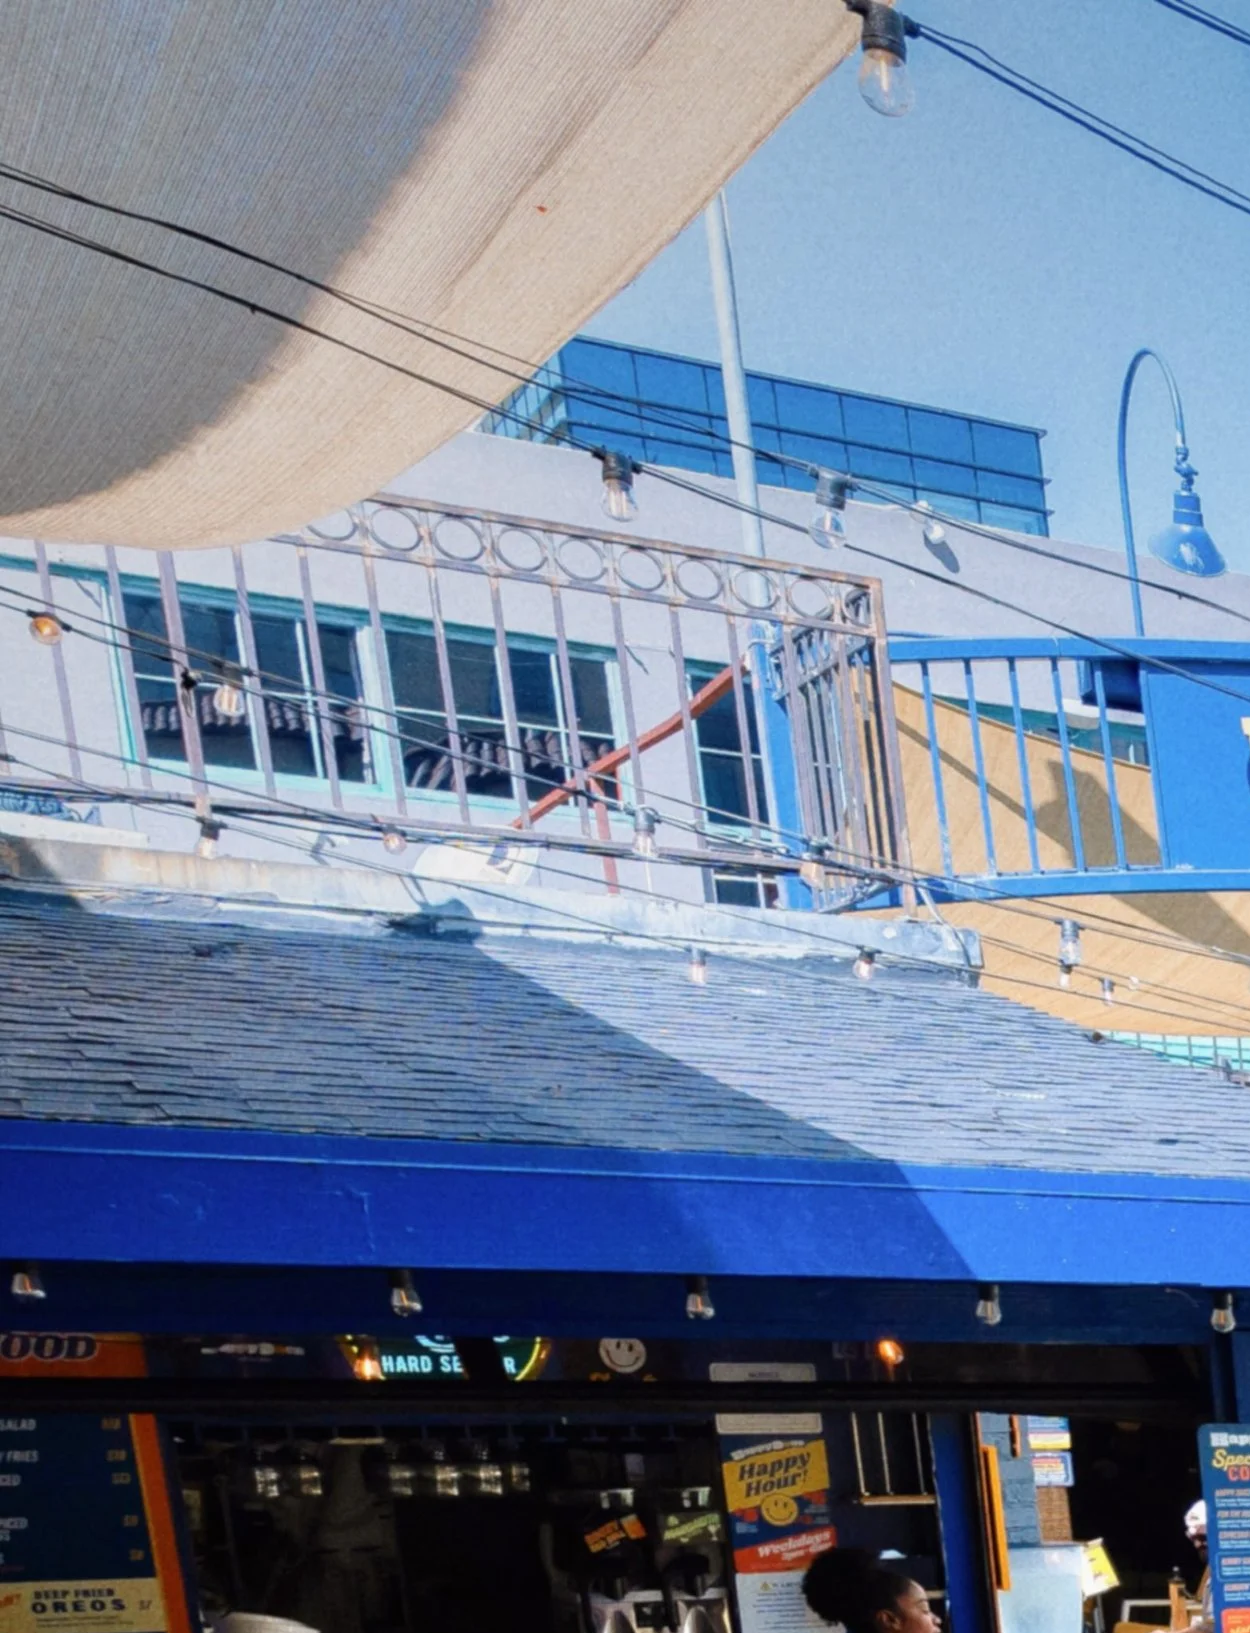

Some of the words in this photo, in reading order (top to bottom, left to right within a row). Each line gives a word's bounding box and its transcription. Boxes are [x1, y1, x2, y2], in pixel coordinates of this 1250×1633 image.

[382, 1355, 432, 1374] HARD
[738, 1451, 811, 1481] Happy
[745, 1470, 809, 1498] Hour!
[758, 1530, 832, 1558] Weekdays
[34, 1589, 69, 1600] DEEP
[75, 1587, 115, 1598] FRIED
[31, 1599, 126, 1614] OREOS
